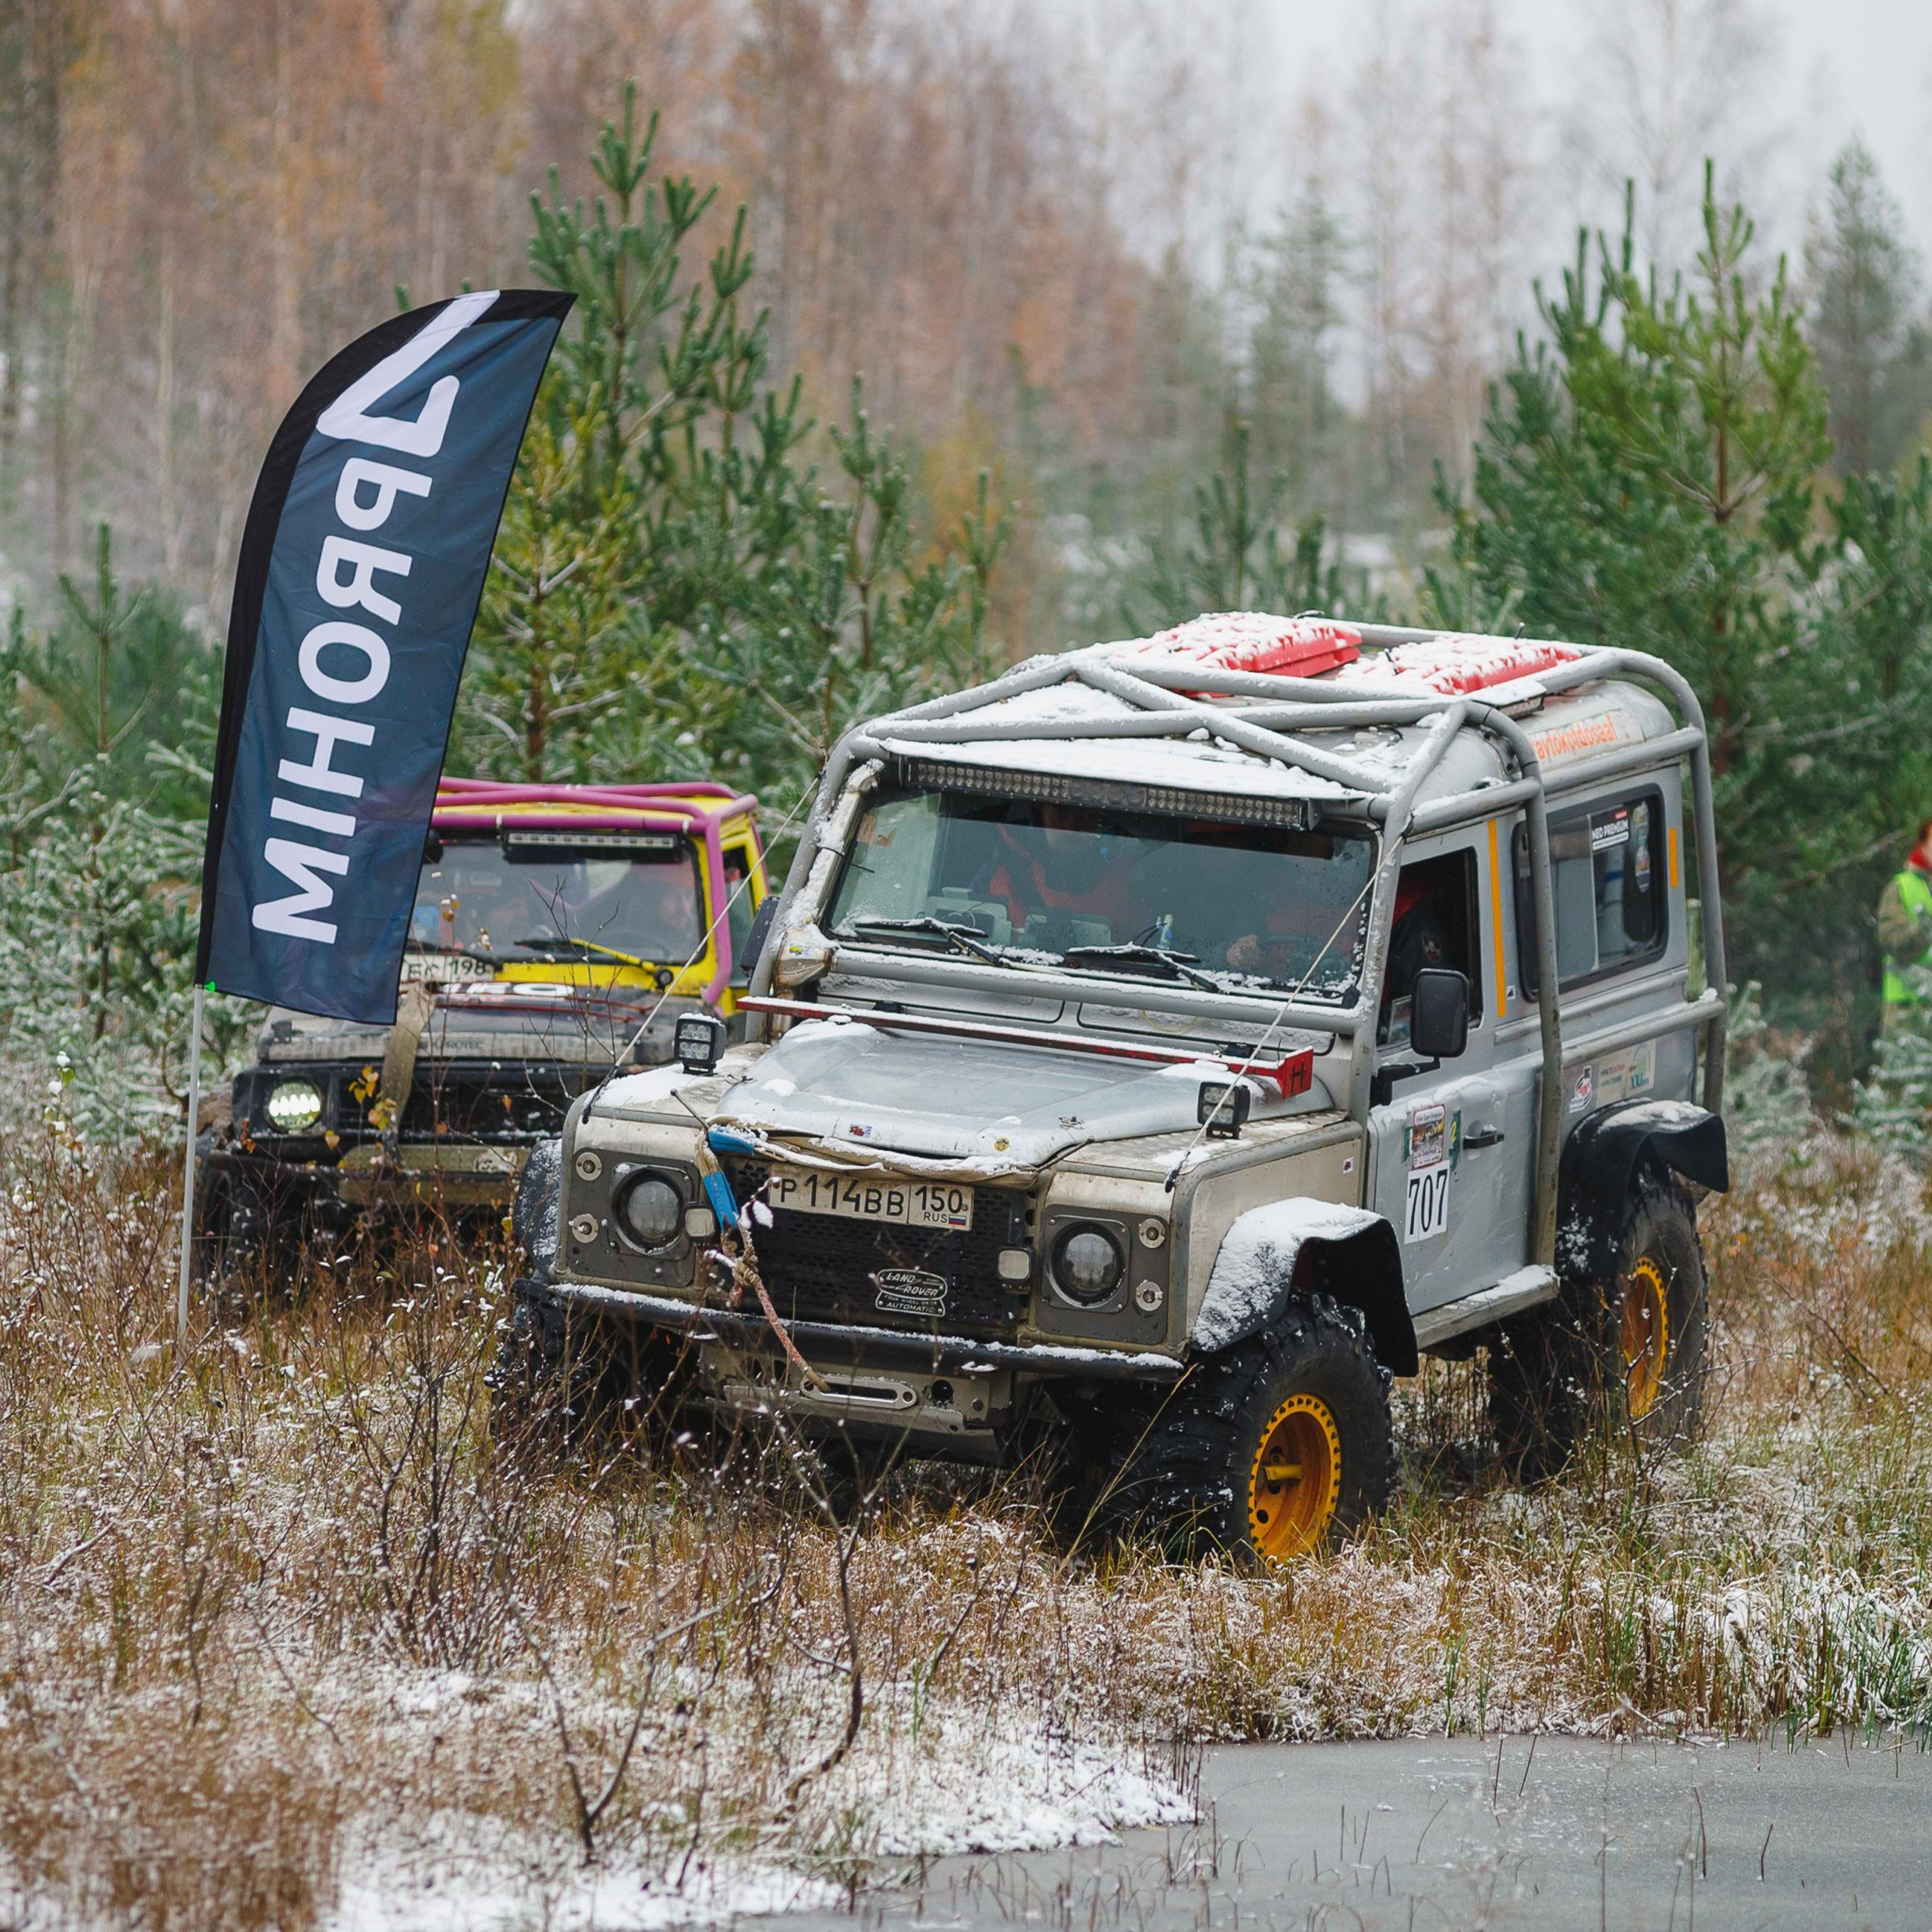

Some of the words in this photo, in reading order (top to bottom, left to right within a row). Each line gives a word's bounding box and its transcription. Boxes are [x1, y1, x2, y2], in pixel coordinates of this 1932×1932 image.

[450, 958, 486, 976] 198
[780, 1174, 905, 1216] P114BB
[914, 1186, 964, 1214] 150
[1408, 1169, 1447, 1235] 707
[924, 1211, 948, 1223] RUS
[886, 1272, 915, 1283] LAND
[903, 1285, 938, 1297] ROVER
[886, 1302, 934, 1313] AUTOMATIC
